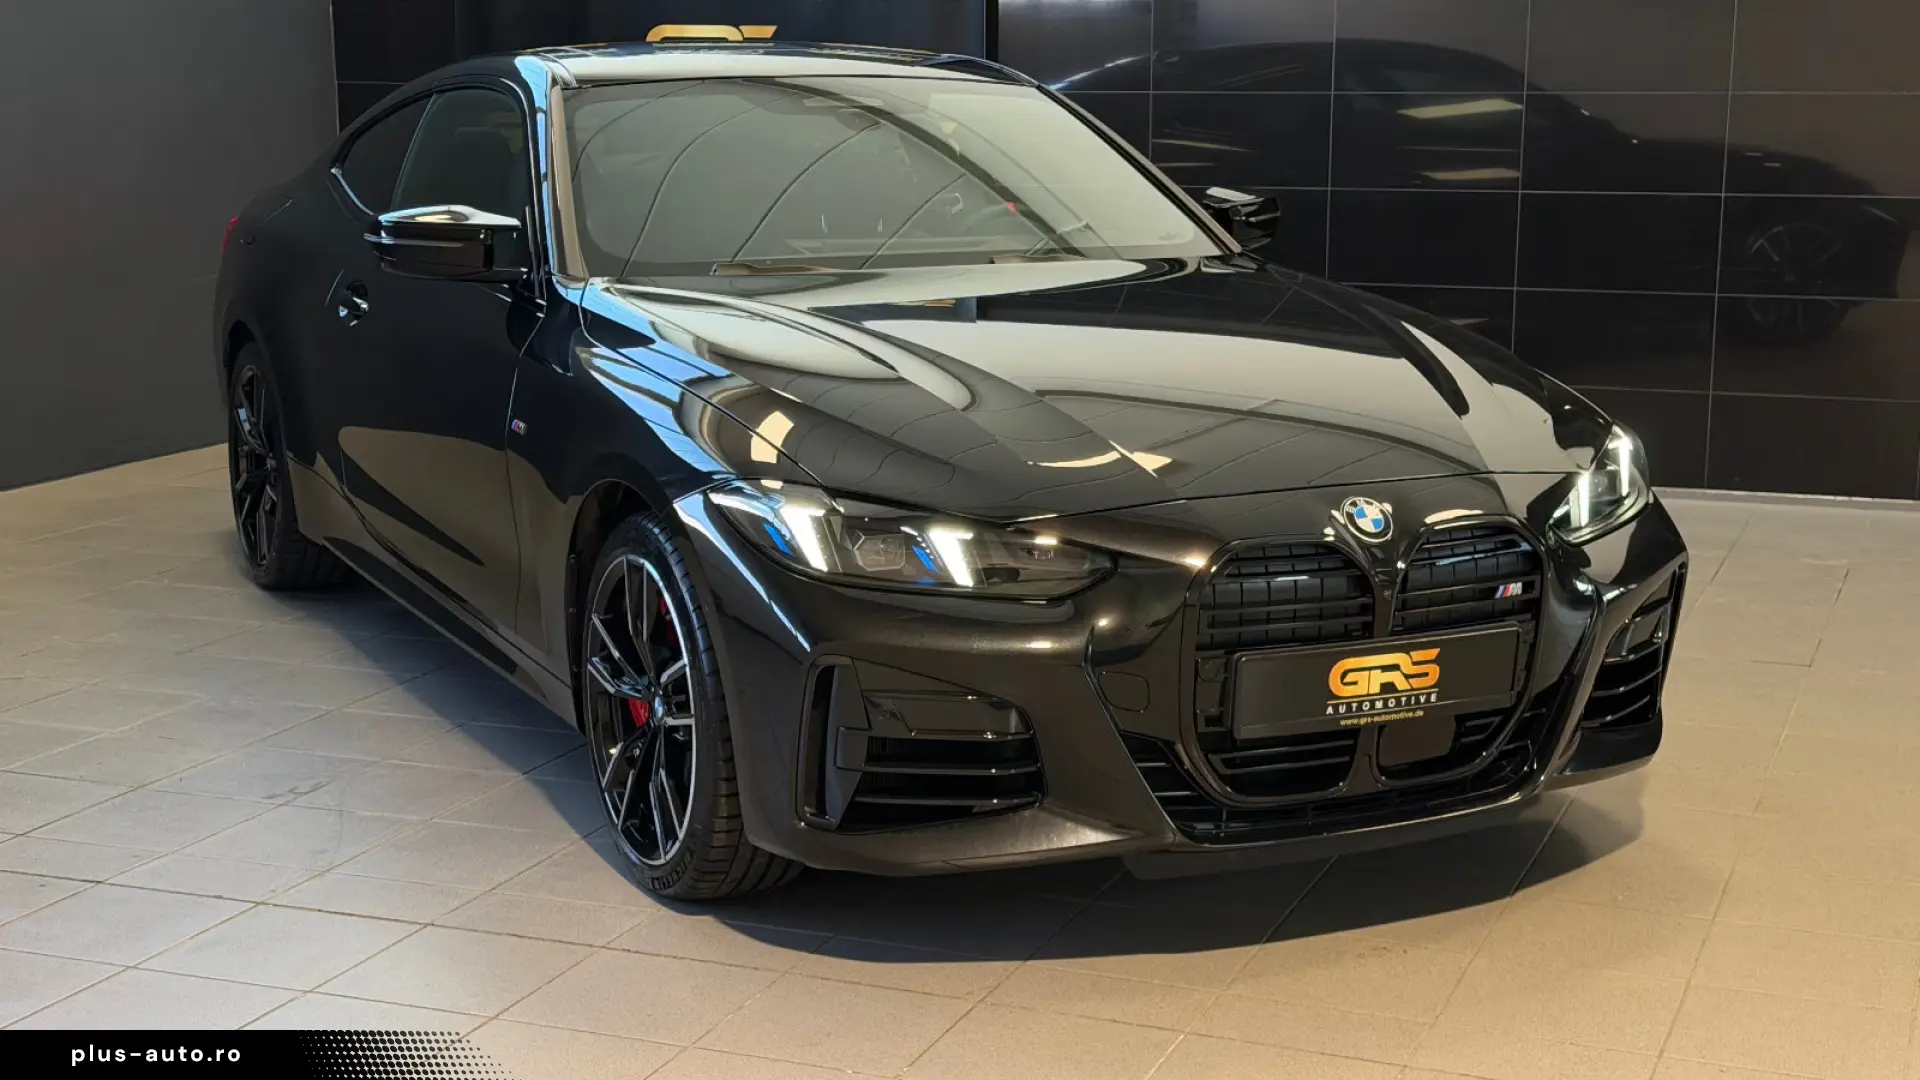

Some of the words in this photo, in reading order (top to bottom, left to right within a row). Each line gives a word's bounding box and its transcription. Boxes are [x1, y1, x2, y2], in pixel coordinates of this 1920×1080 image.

[1328, 648, 1441, 697] GRS
[1325, 693, 1438, 715] AUTOMOTIVE
[1340, 710, 1424, 726] www.grs-automotive.de
